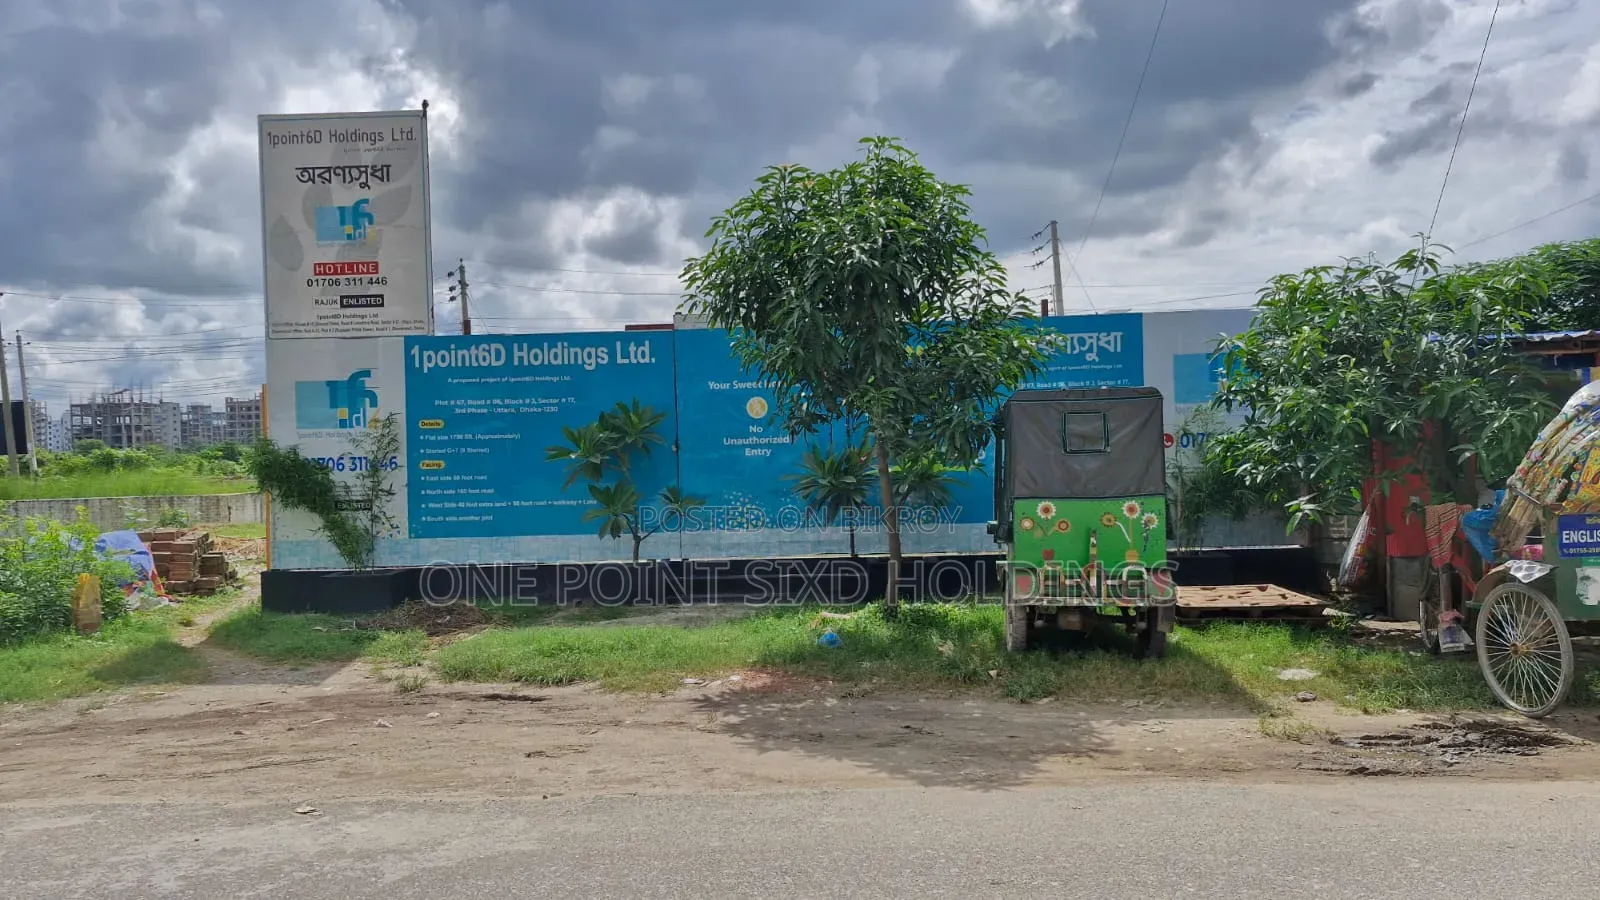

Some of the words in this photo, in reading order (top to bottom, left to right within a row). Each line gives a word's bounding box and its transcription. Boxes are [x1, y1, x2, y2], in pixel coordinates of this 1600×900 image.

[267, 130, 322, 149] 1point6D
[329, 128, 384, 146] Holdings
[391, 127, 417, 142] Ltd.
[295, 164, 392, 190] অরণ্যসুধা
[315, 263, 377, 274] HOTLINE
[306, 278, 341, 288] 01706
[345, 277, 363, 287] 311
[367, 276, 388, 286] 446
[314, 298, 339, 306] RAJUK
[343, 297, 383, 306] ENLISTED
[1035, 331, 1123, 362] রণ্যসুধা
[411, 342, 506, 373] 1point6D
[513, 341, 609, 371] Holdings
[616, 340, 656, 365] Ltd.
[708, 381, 730, 390] Your
[733, 380, 762, 389] Sweet
[749, 425, 763, 433] No
[723, 434, 790, 446] Unauthorized
[745, 447, 772, 457] Entry
[349, 456, 368, 472] 311
